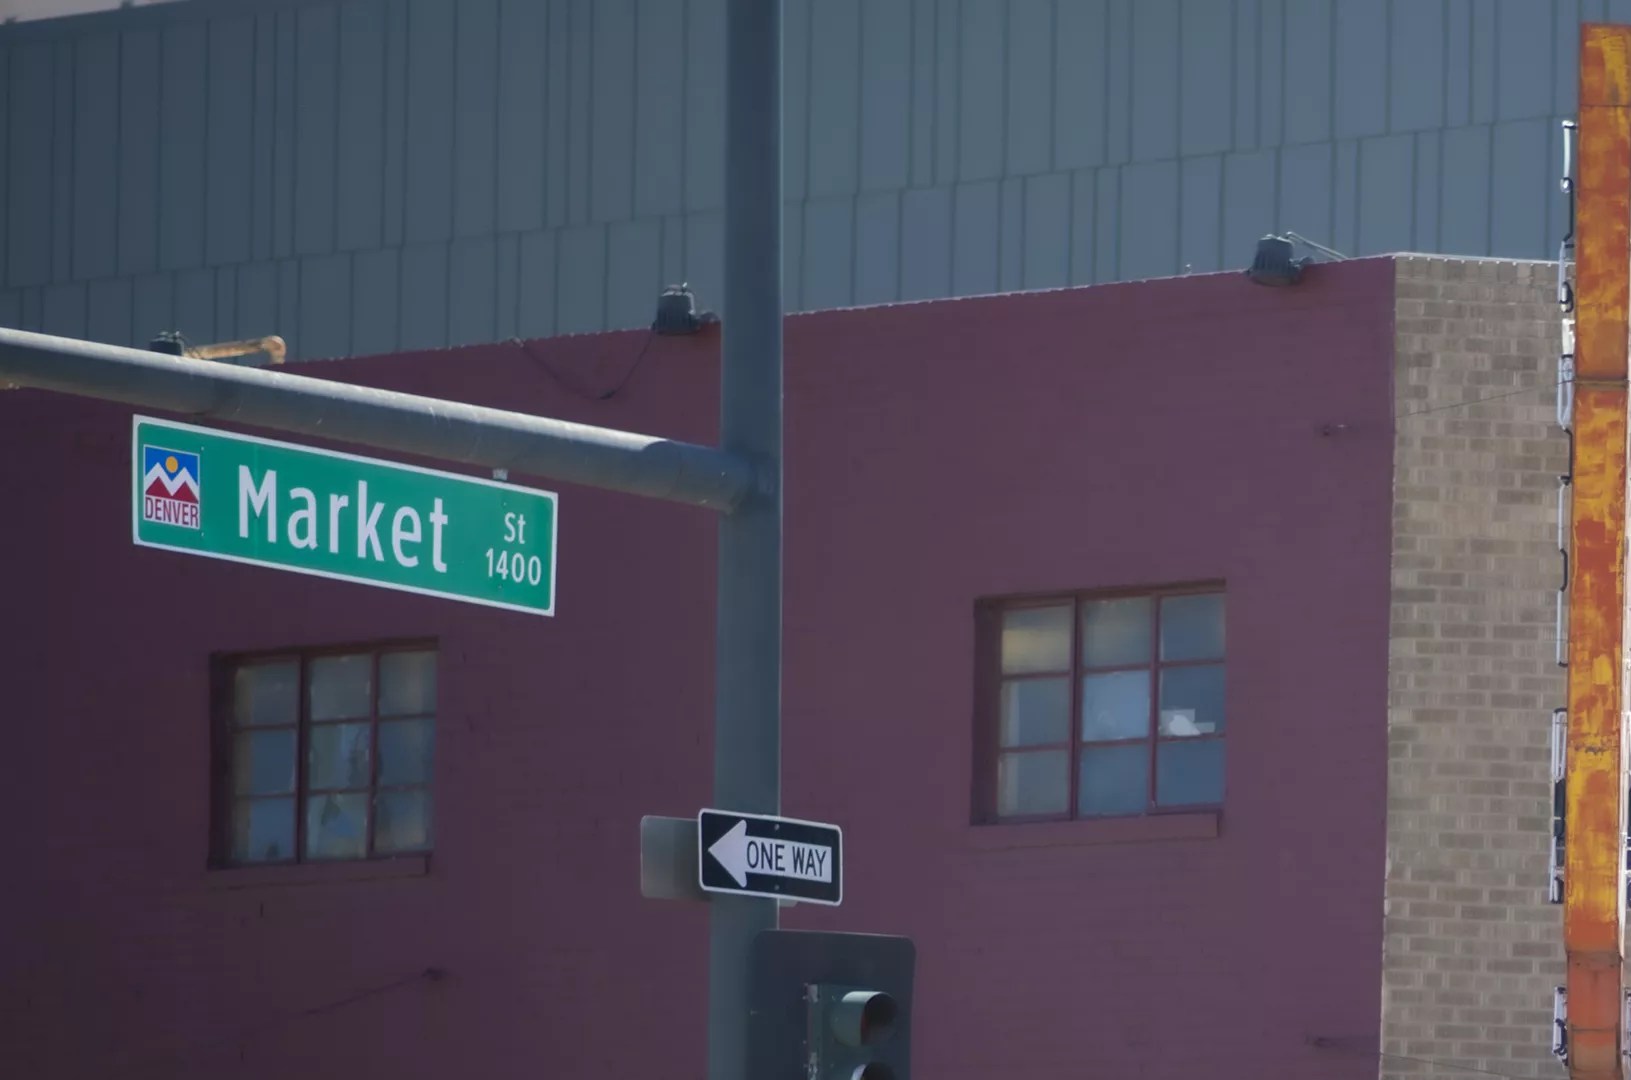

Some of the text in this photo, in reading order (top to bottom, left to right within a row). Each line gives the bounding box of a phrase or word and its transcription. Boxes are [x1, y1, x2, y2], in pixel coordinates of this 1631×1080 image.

[144, 496, 199, 529] DENVER
[238, 464, 449, 574] Market
[503, 511, 526, 545] St
[484, 547, 542, 586] 1400
[746, 840, 827, 877] ONE WAY
